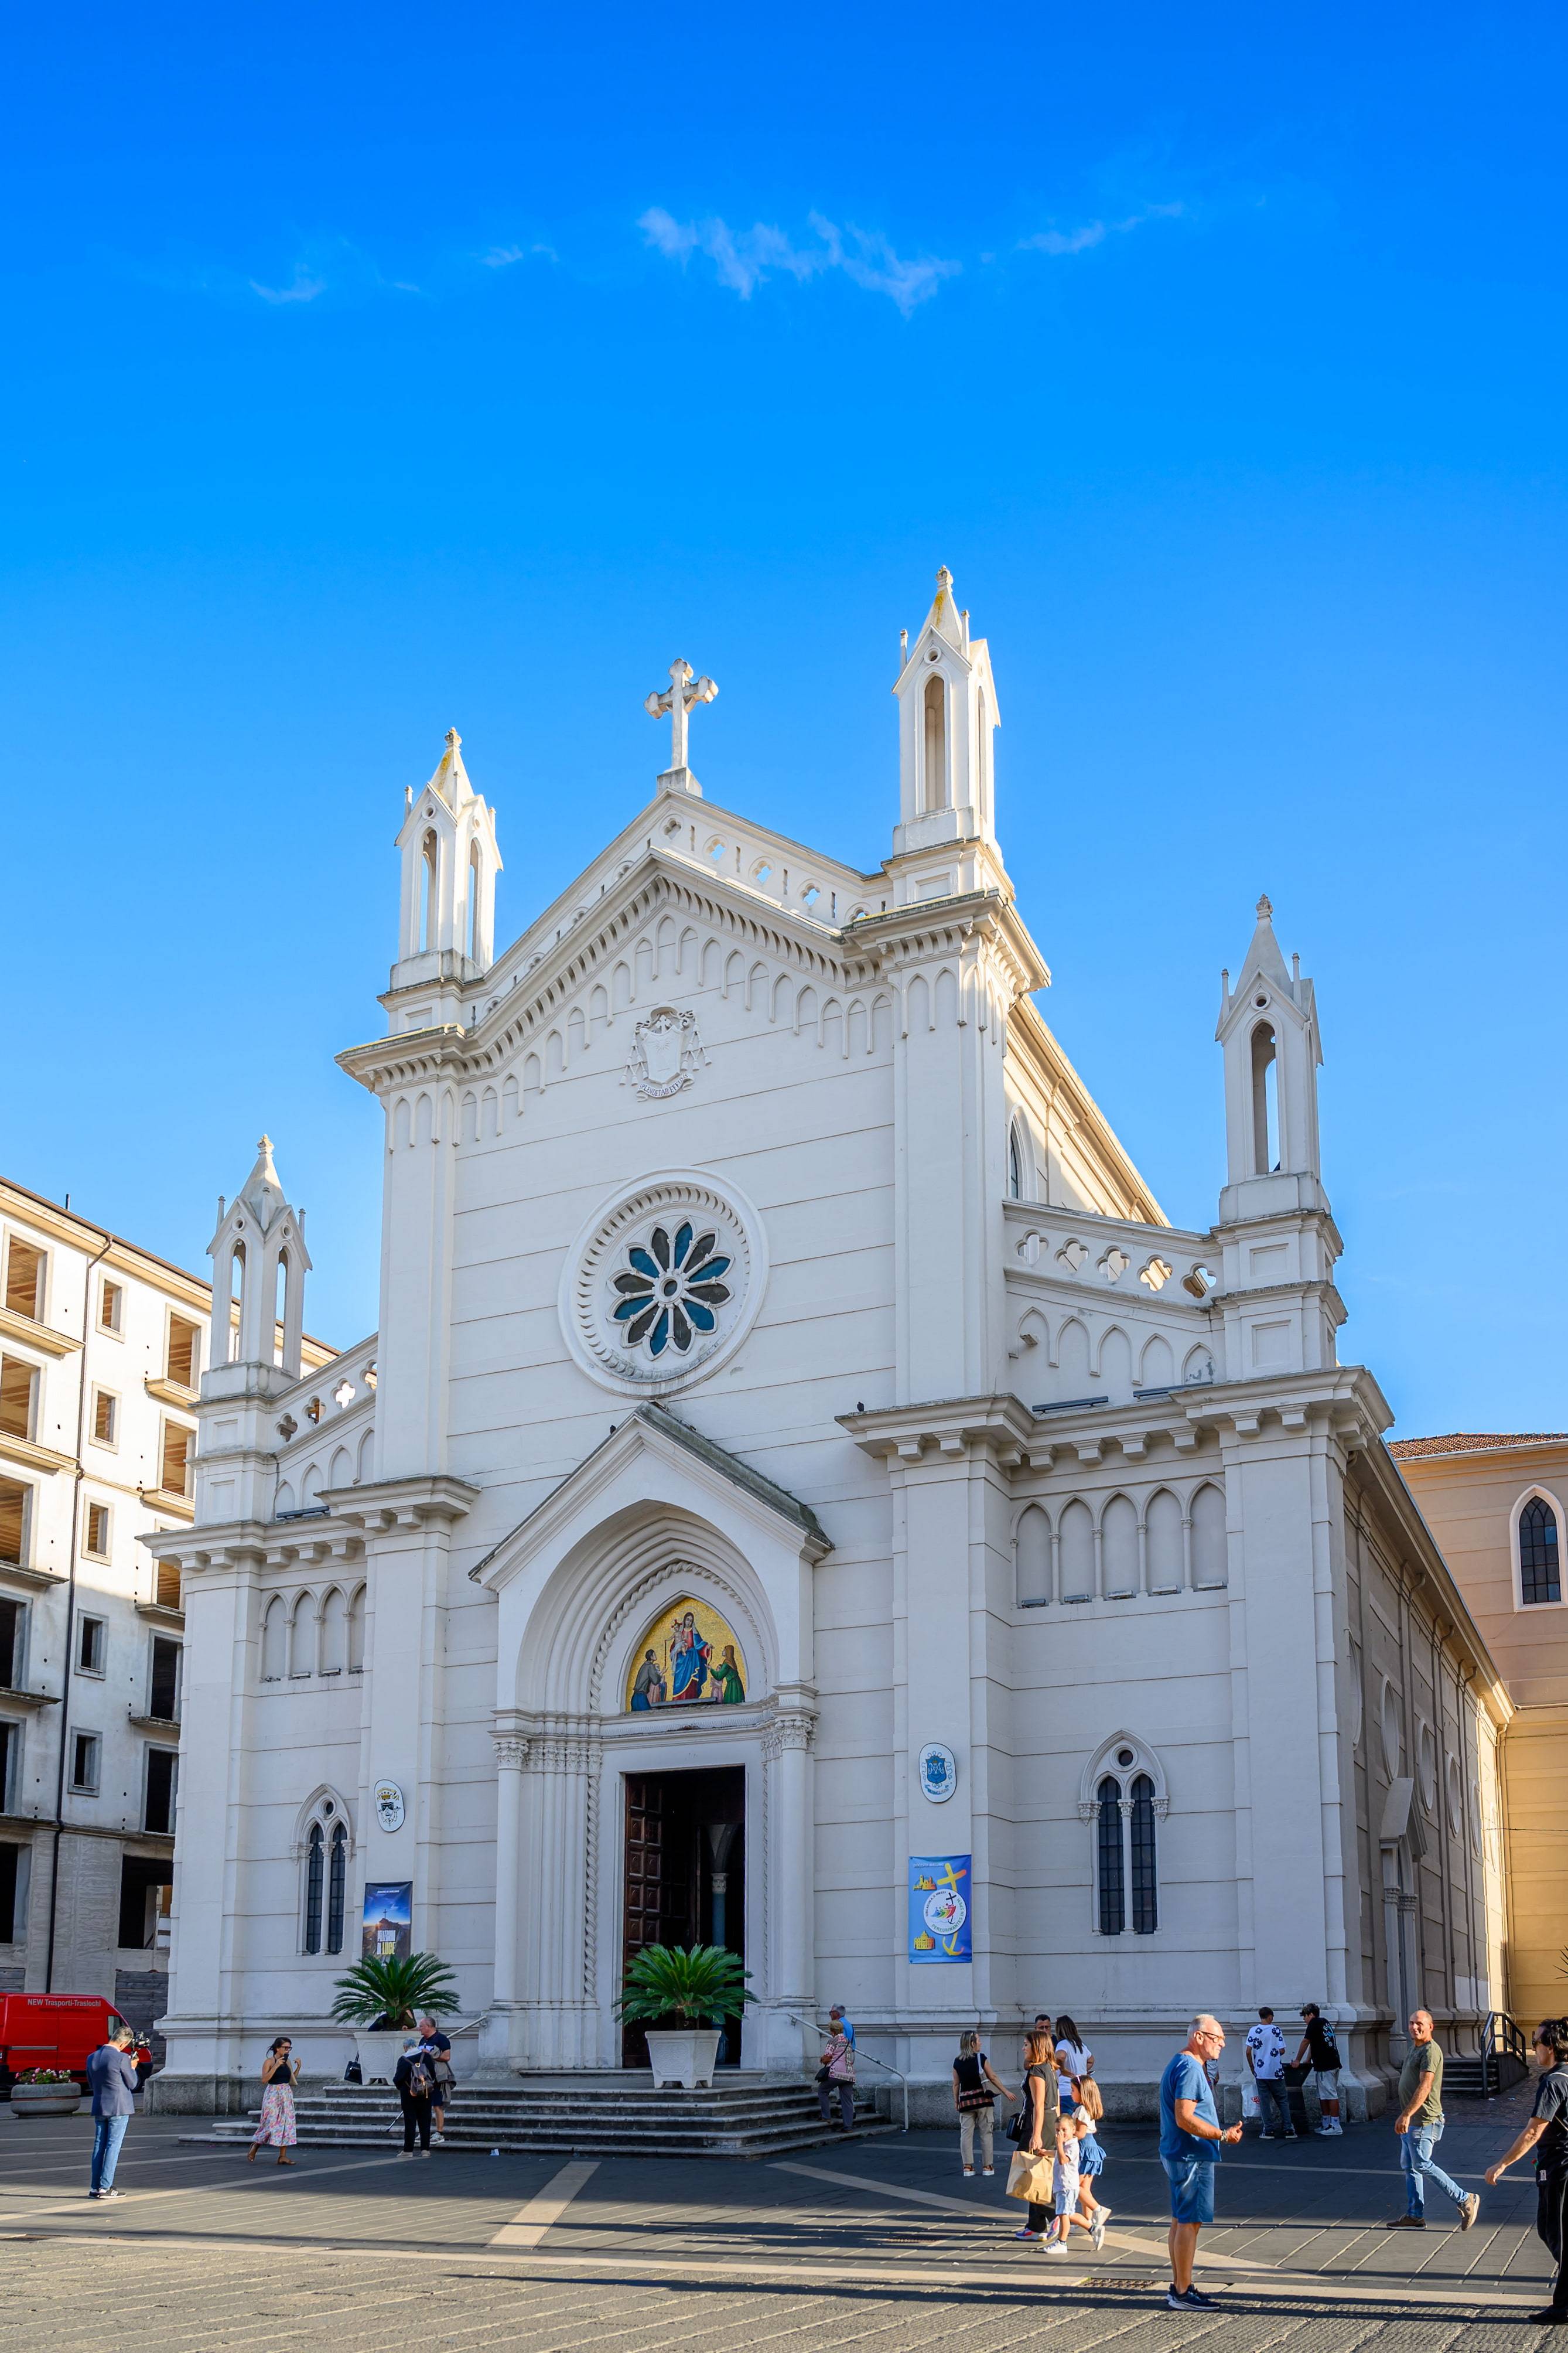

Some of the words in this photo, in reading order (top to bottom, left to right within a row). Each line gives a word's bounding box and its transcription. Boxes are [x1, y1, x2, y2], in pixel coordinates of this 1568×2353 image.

[931, 1918, 963, 1932] PEREGRINANTES
[382, 1942, 397, 1955] LUCE
[45, 1999, 101, 2007] Trasporti-Traslochi
